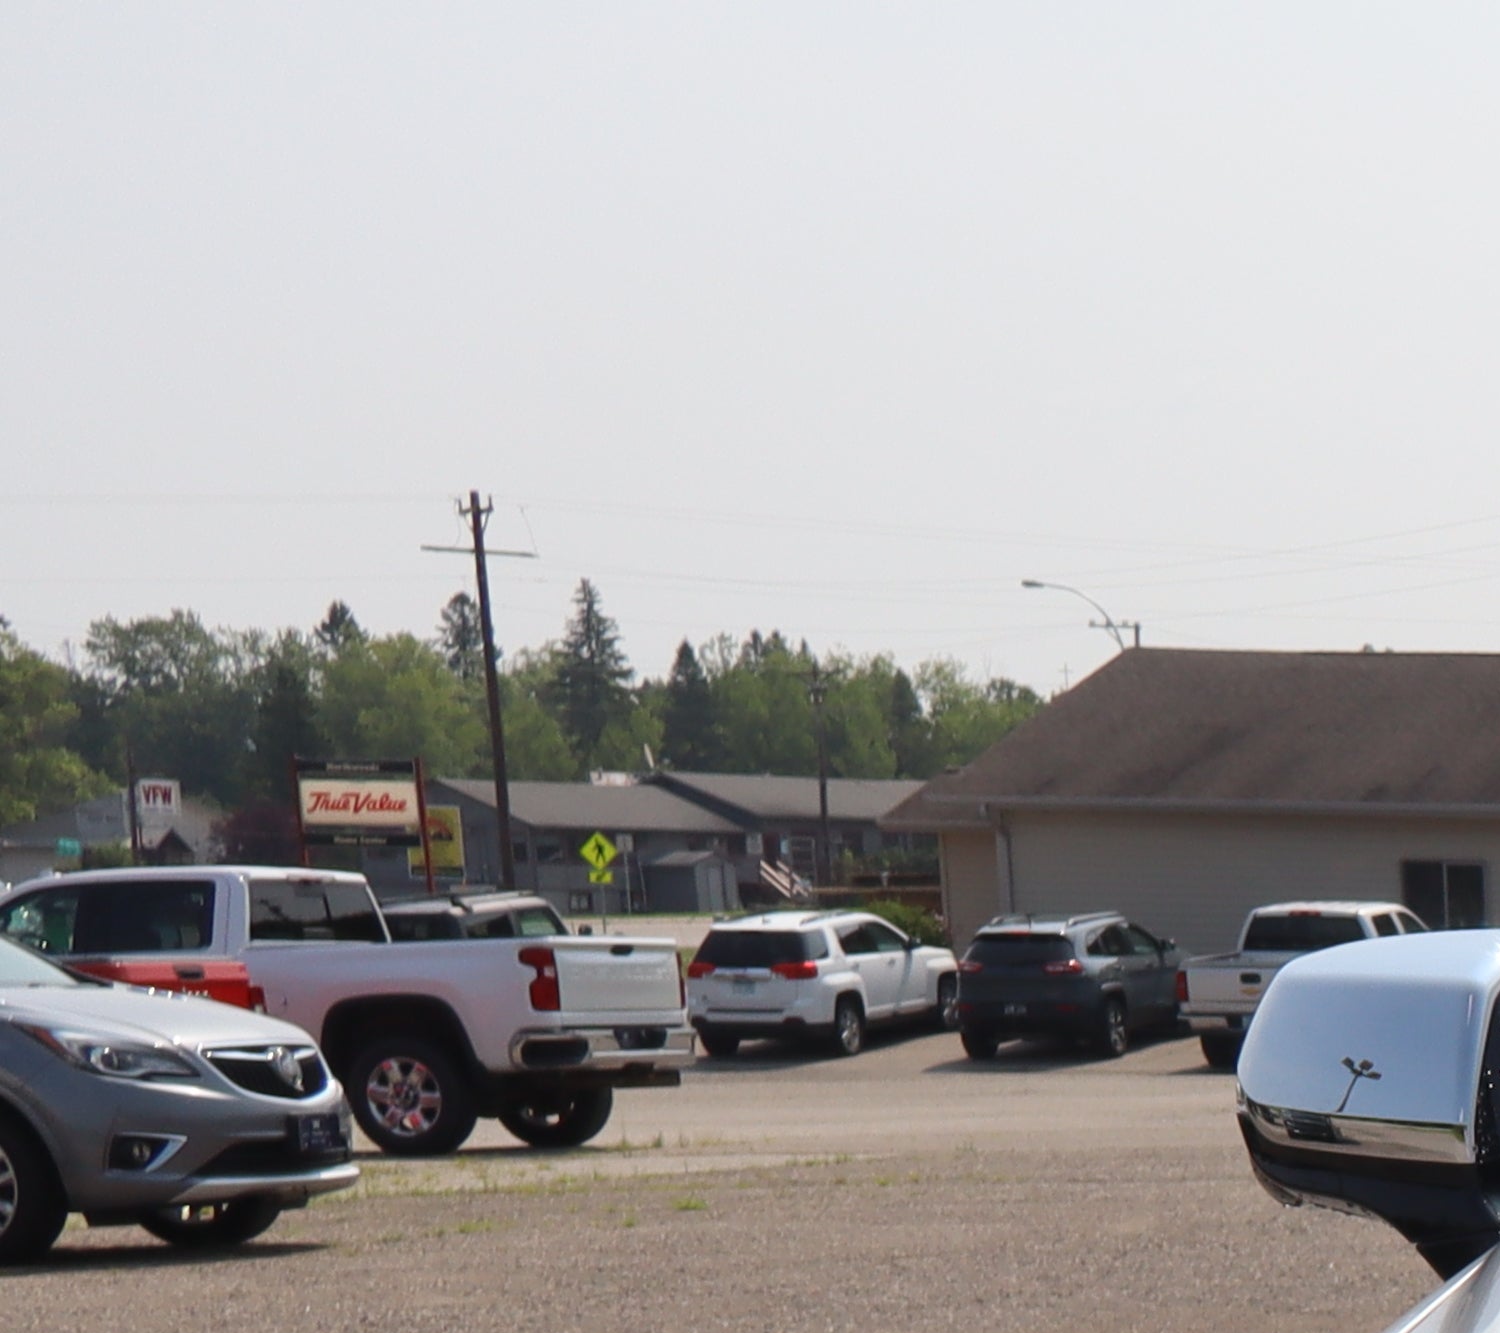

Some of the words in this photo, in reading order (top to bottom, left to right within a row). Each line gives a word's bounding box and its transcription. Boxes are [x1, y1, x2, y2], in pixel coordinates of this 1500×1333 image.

[142, 784, 172, 806] VFW
[307, 790, 350, 813] True
[350, 791, 407, 813] Value
